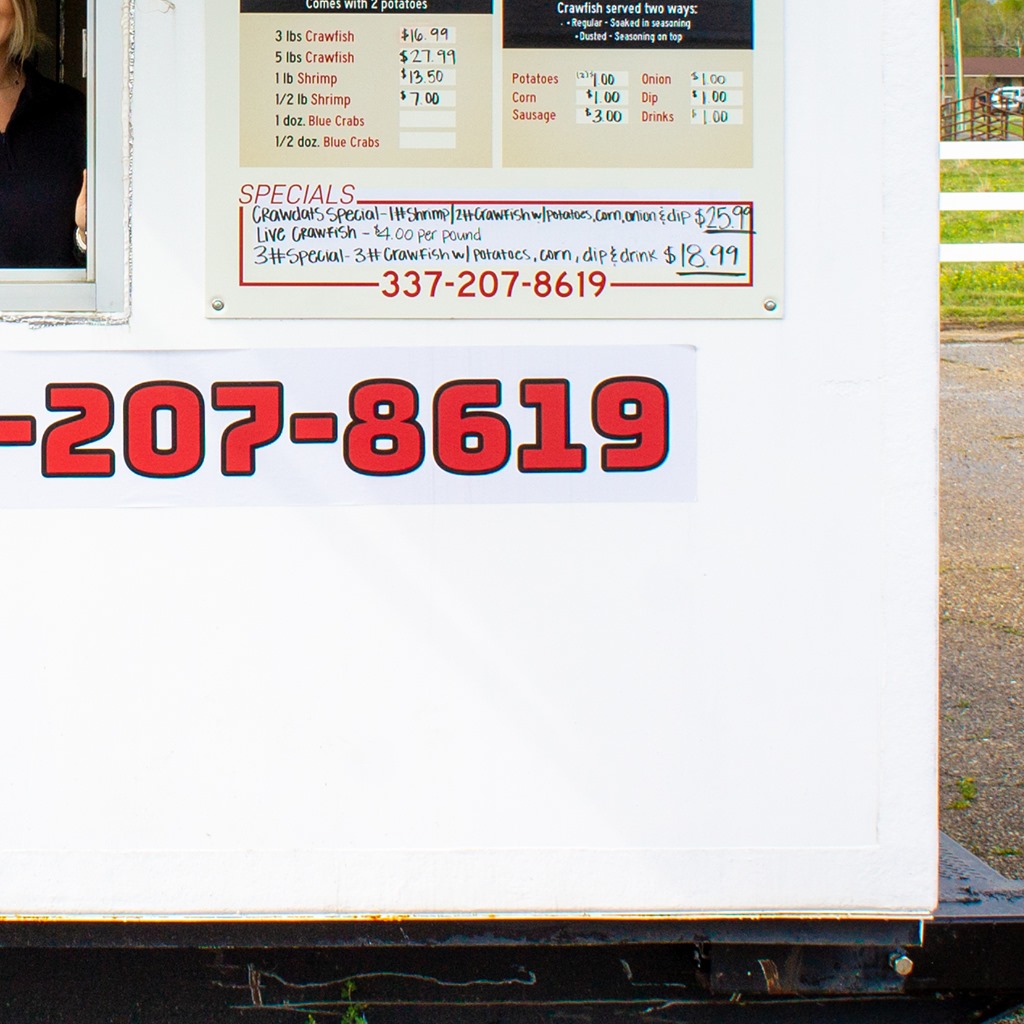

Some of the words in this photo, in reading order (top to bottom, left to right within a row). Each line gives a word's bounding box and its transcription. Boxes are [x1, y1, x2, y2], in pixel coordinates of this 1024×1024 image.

[557, 2, 603, 14] Crawfish
[605, 2, 641, 14] served
[644, 2, 664, 14] two
[667, 4, 698, 18] ways:
[609, 18, 640, 27] Soaked
[641, 18, 650, 27] in
[651, 18, 691, 30] seasoning
[275, 31, 283, 42] 3
[286, 30, 302, 42] lbs
[305, 30, 355, 42] Crawfish
[401, 27, 449, 43] $16.99
[614, 32, 655, 43] Seasoning
[669, 32, 683, 43] top
[275, 52, 283, 63] 5
[286, 51, 302, 63] lbs
[305, 51, 355, 63] Crawfish
[275, 73, 279, 84] 1
[283, 72, 293, 84] lb
[297, 72, 338, 88] Shrimp
[400, 67, 444, 85] $13.50
[512, 73, 559, 85] Potatoes
[641, 73, 672, 85] Onion
[275, 94, 294, 105] 1/2
[297, 93, 308, 105] lb
[311, 94, 351, 109] Shrimp
[512, 92, 537, 103] Corn
[641, 92, 658, 106] Dip
[275, 115, 279, 126] 1
[283, 114, 306, 126] doz.
[309, 114, 331, 126] Blue
[335, 114, 365, 126] Crabs
[512, 109, 557, 123] Sausage
[641, 111, 675, 122] Drinks
[275, 136, 294, 147] 1/2
[297, 135, 320, 147] doz.
[323, 136, 346, 147] Blue
[350, 136, 380, 147] Crabs
[238, 184, 356, 205] SPECIALS
[417, 229, 437, 243] per
[442, 227, 481, 243] pound
[381, 270, 607, 298] 337-207-8619
